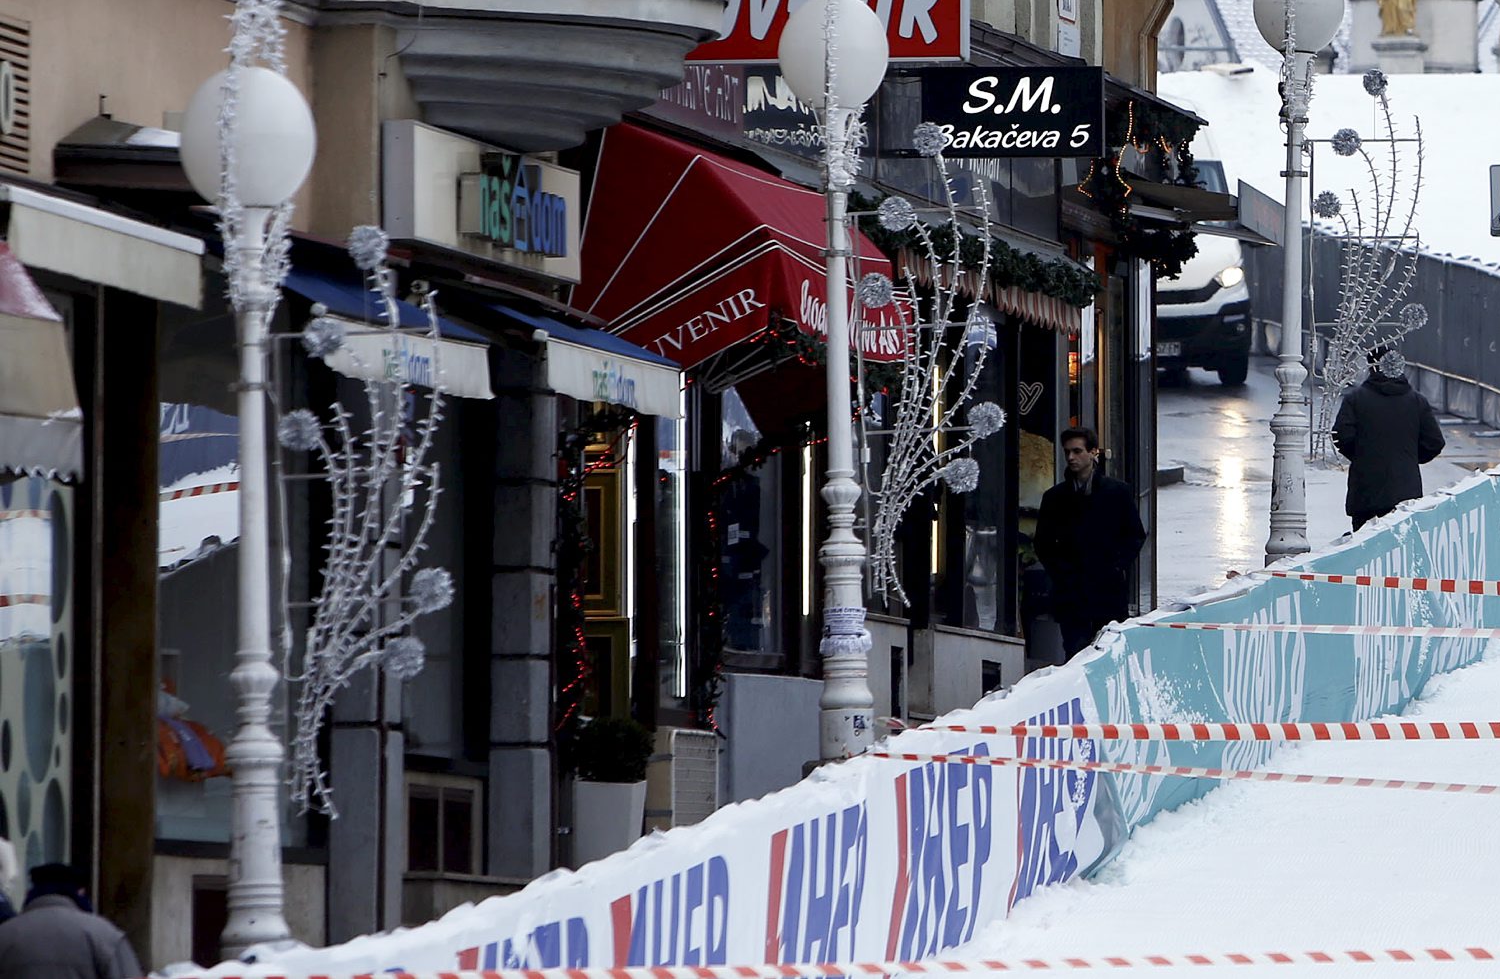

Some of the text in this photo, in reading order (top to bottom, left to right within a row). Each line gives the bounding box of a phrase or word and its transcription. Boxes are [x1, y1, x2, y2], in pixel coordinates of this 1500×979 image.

[962, 76, 1061, 114] S.M.
[941, 124, 1091, 148] Bakačeva 5
[479, 155, 567, 258] naš dom
[800, 279, 828, 335] Croa
